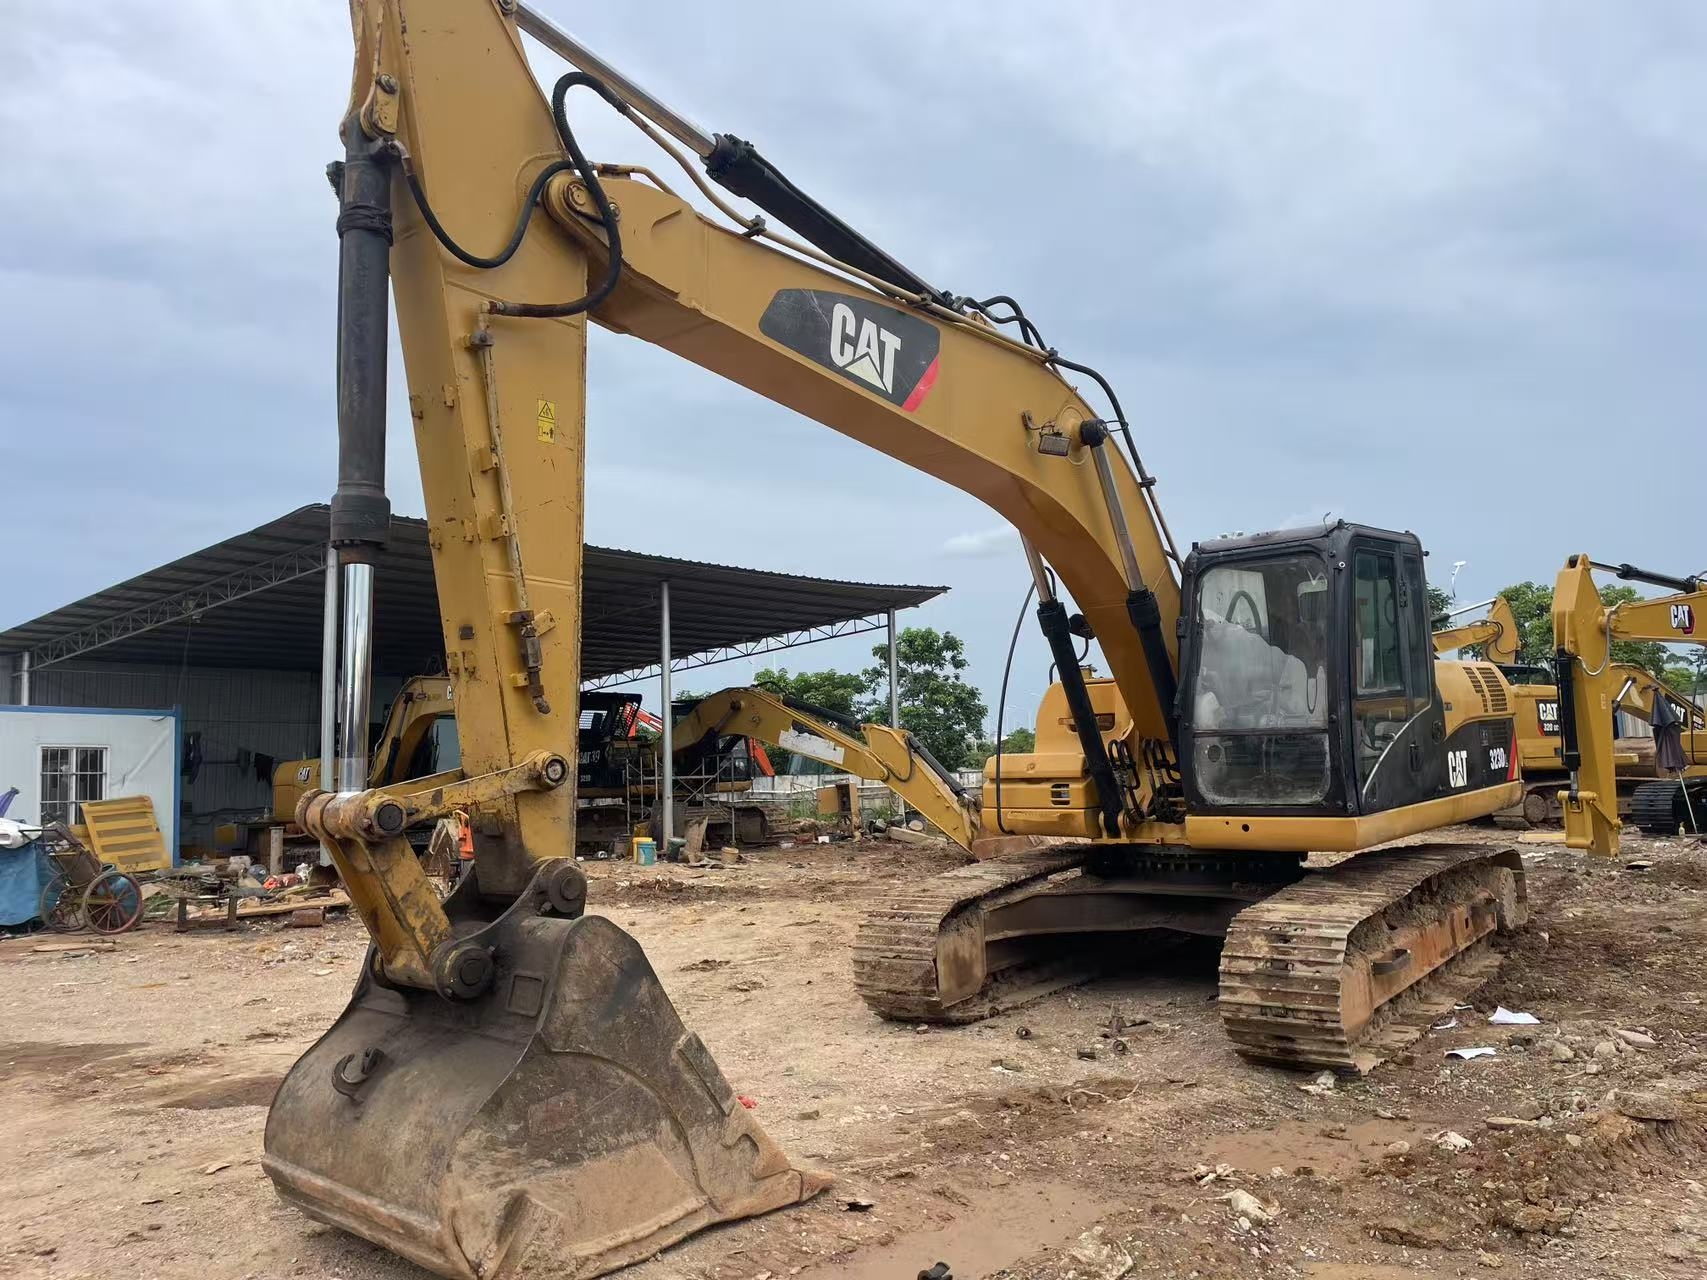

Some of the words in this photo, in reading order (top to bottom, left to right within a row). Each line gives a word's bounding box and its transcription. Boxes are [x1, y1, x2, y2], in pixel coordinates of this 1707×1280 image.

[830, 303, 901, 394] CAT
[1670, 604, 1689, 628] CAT
[1538, 703, 1558, 720] CAT
[1447, 750, 1467, 788] CAT
